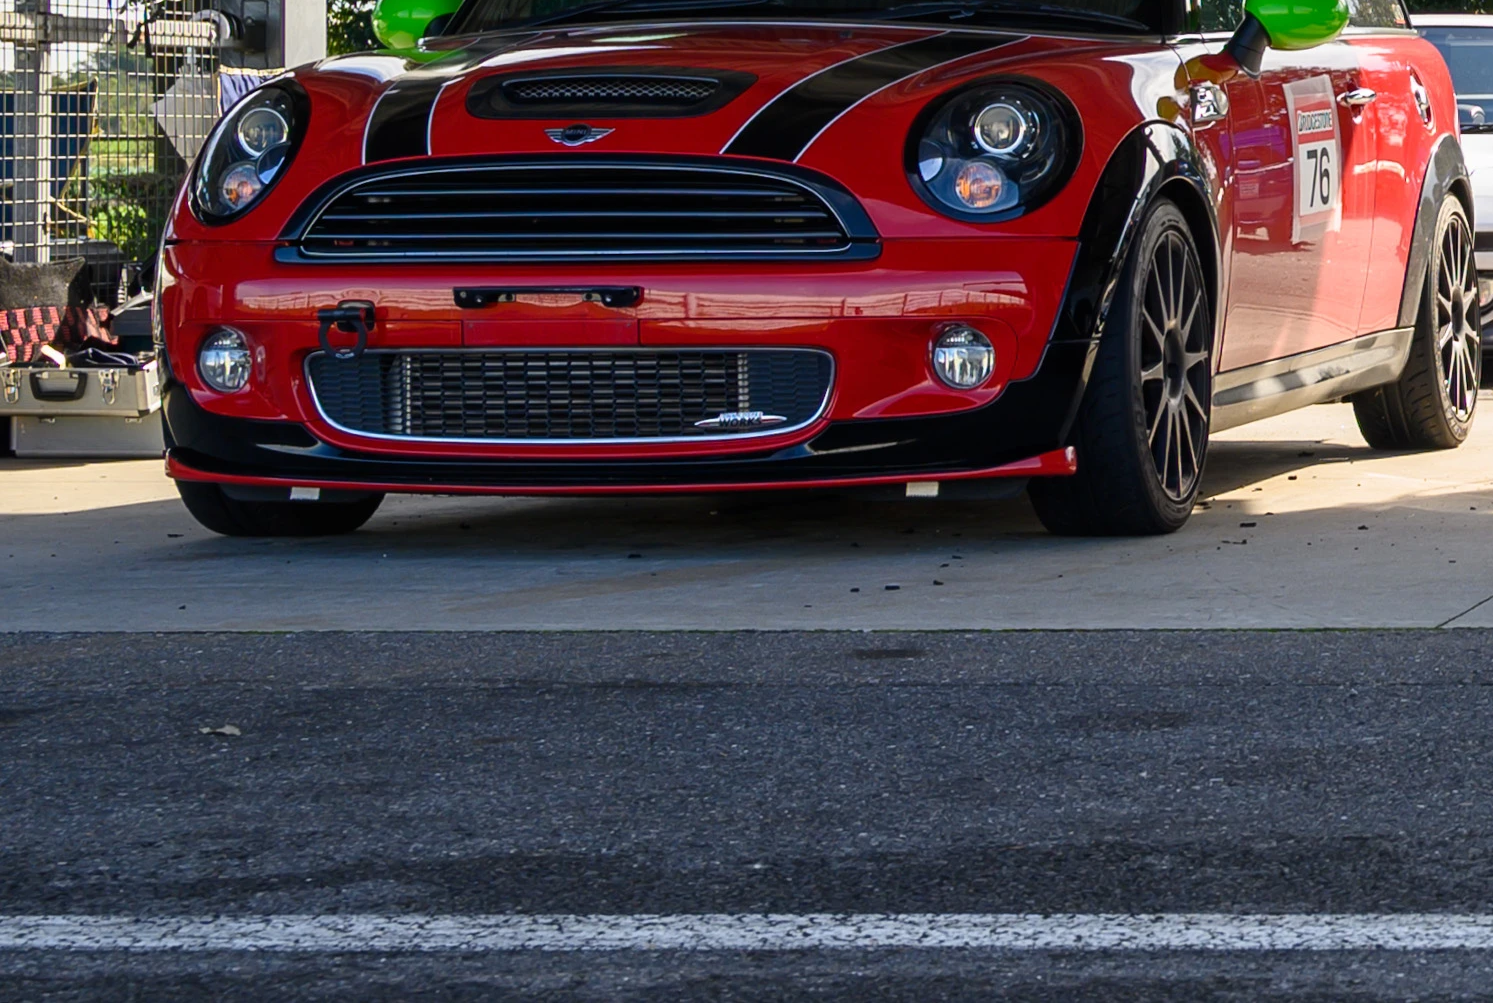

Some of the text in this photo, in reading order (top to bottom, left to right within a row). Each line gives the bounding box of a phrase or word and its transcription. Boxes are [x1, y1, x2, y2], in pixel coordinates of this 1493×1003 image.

[1298, 110, 1333, 133] BRIDGESTONE
[1306, 147, 1331, 208] 76
[720, 418, 762, 427] WORKS
